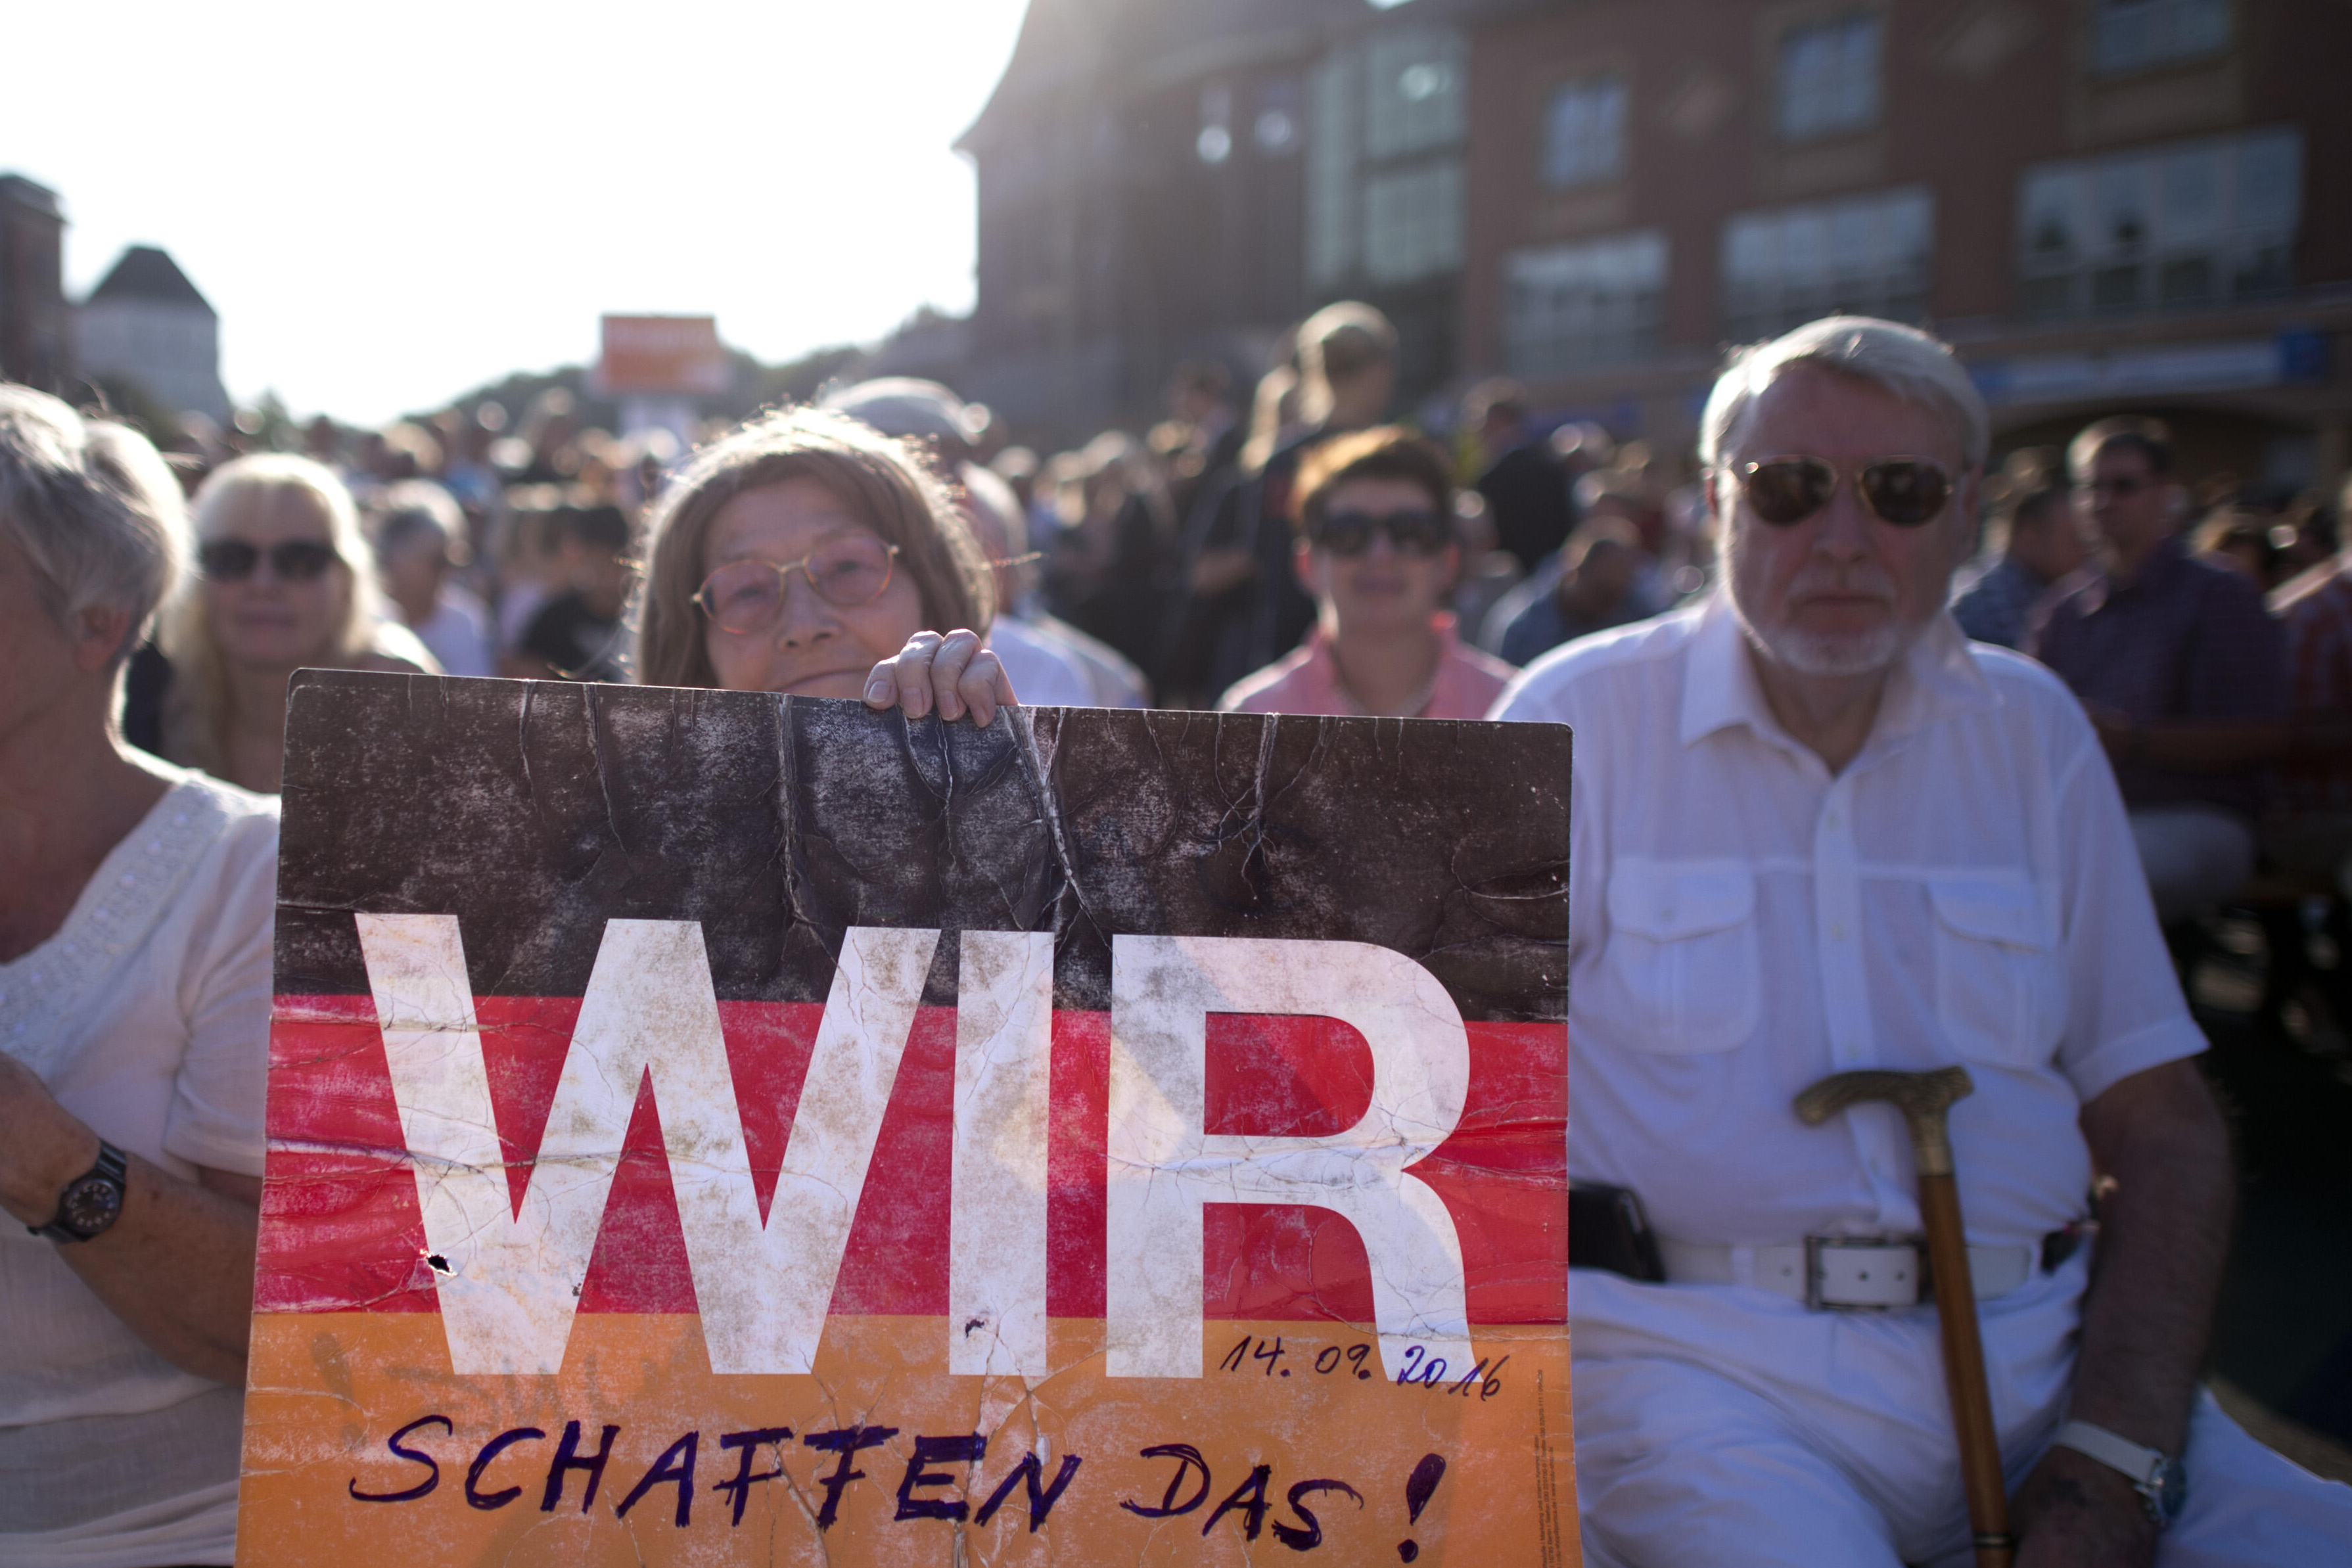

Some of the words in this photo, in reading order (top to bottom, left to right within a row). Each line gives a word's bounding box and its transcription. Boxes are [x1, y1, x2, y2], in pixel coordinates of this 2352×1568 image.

[354, 912, 1483, 1383] WIR
[1220, 1336, 1291, 1377] 14.
[1314, 1344, 1371, 1379] 09.
[1396, 1345, 1510, 1401] 2016
[349, 1414, 1083, 1533] SCHAFFEN
[1119, 1444, 1364, 1552] DAS
